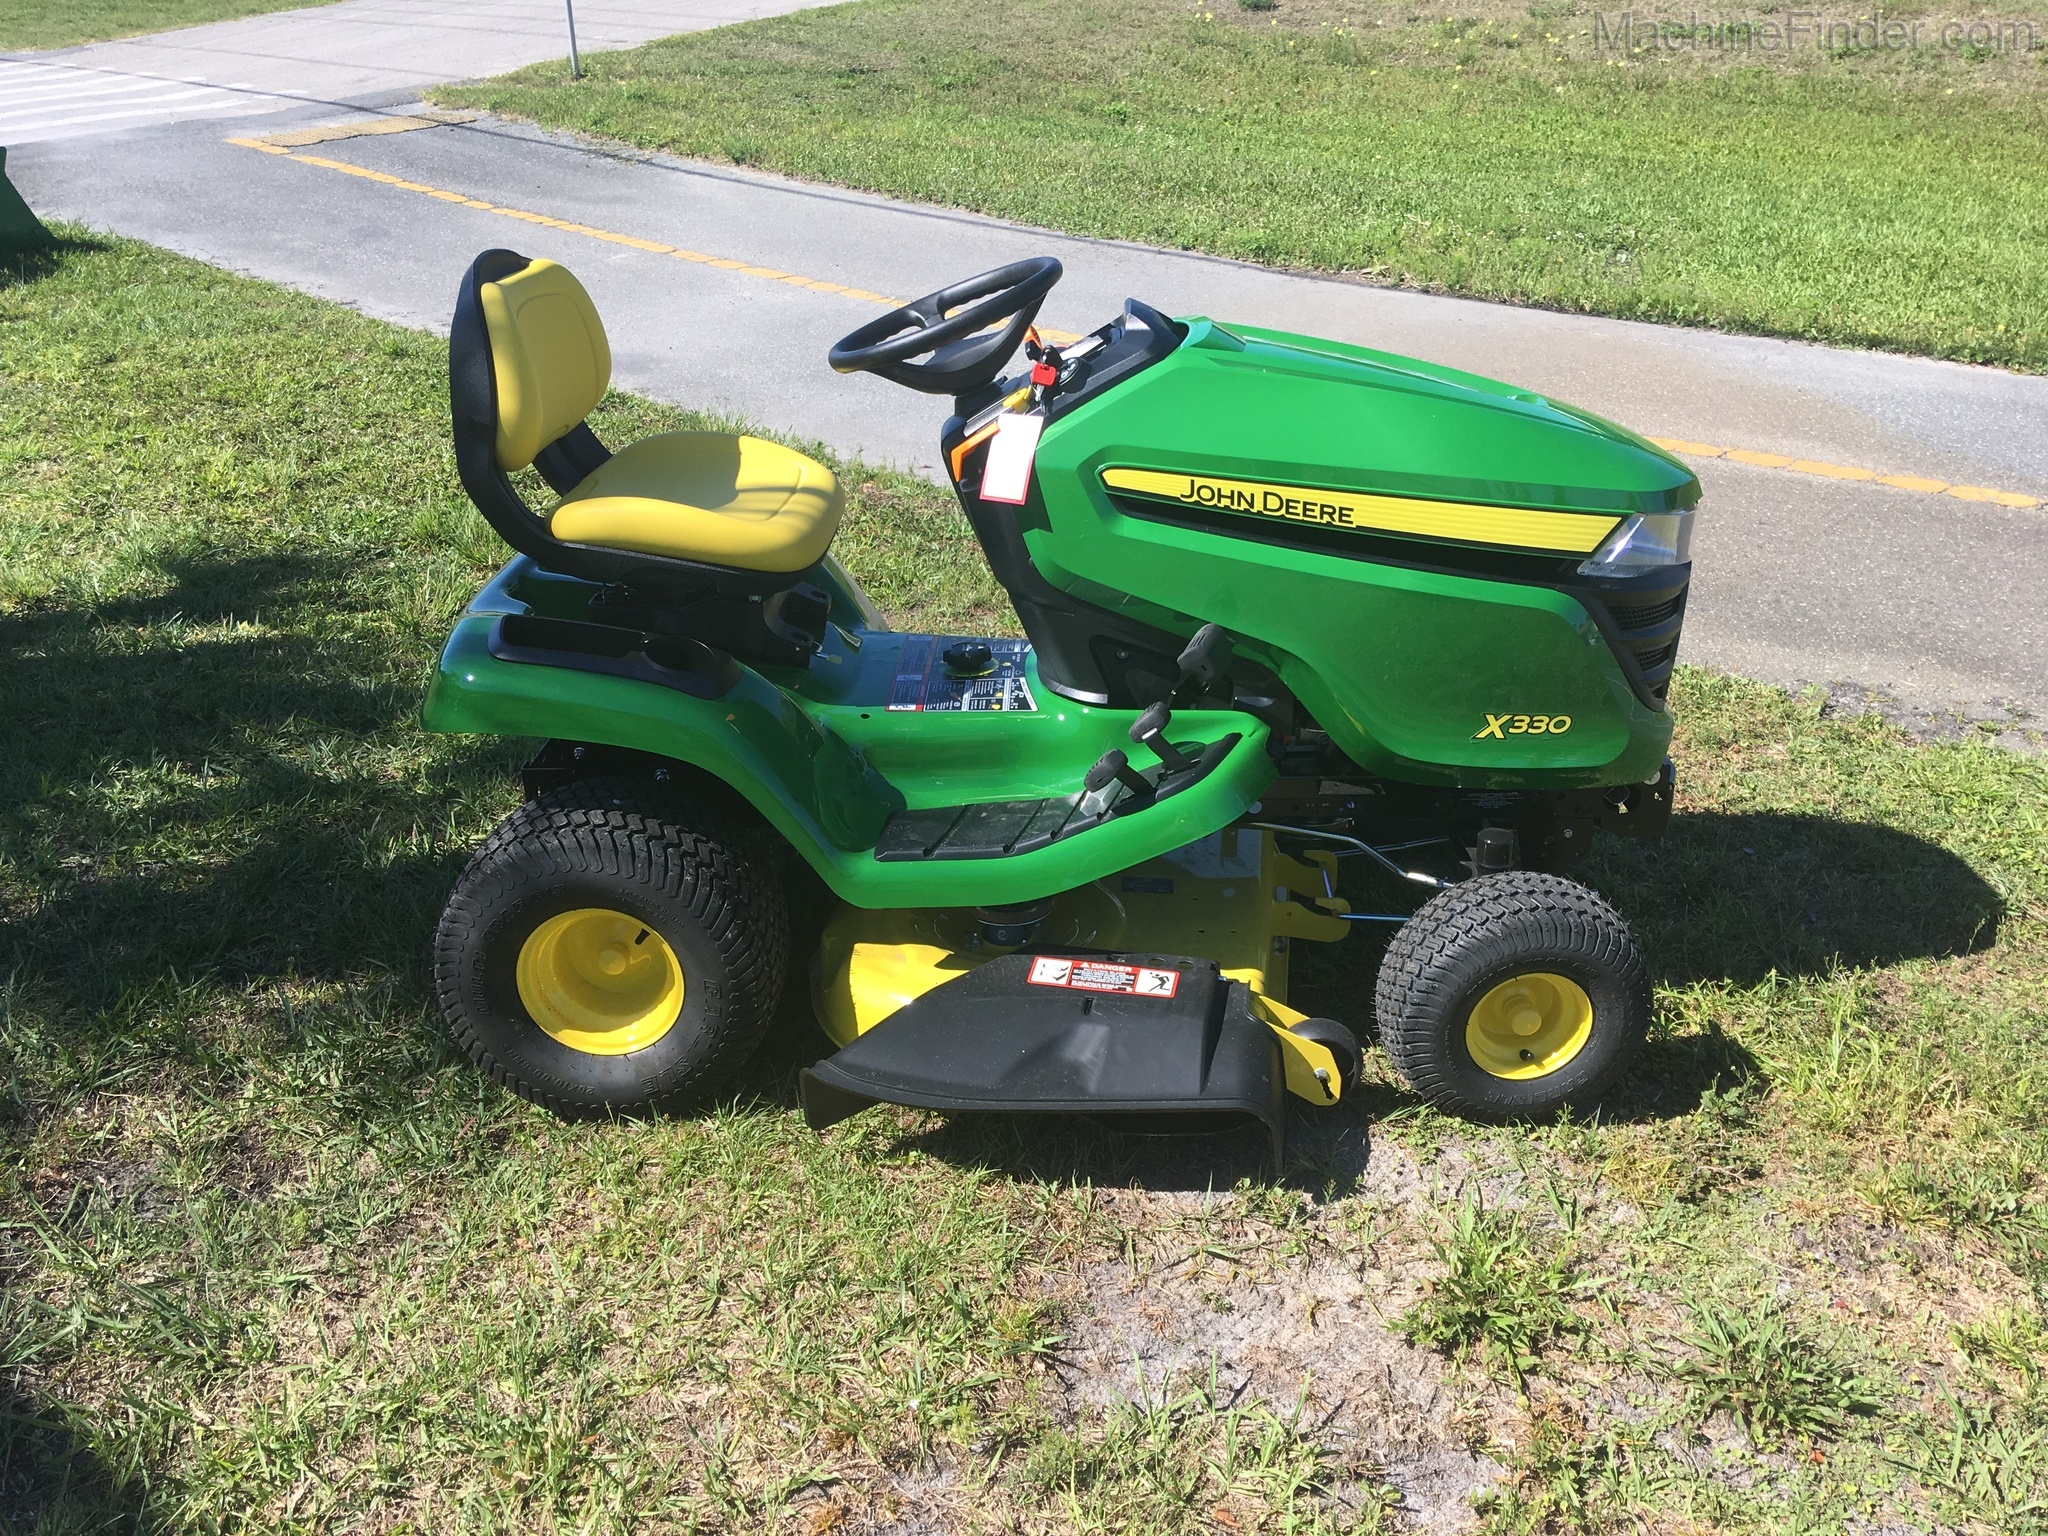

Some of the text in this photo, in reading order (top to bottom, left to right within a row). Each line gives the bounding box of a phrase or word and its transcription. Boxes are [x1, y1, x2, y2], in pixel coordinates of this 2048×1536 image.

[1180, 479, 1355, 525] JOHN DEERE
[1474, 713, 1573, 740] X330
[1091, 962, 1132, 973] DANGER
